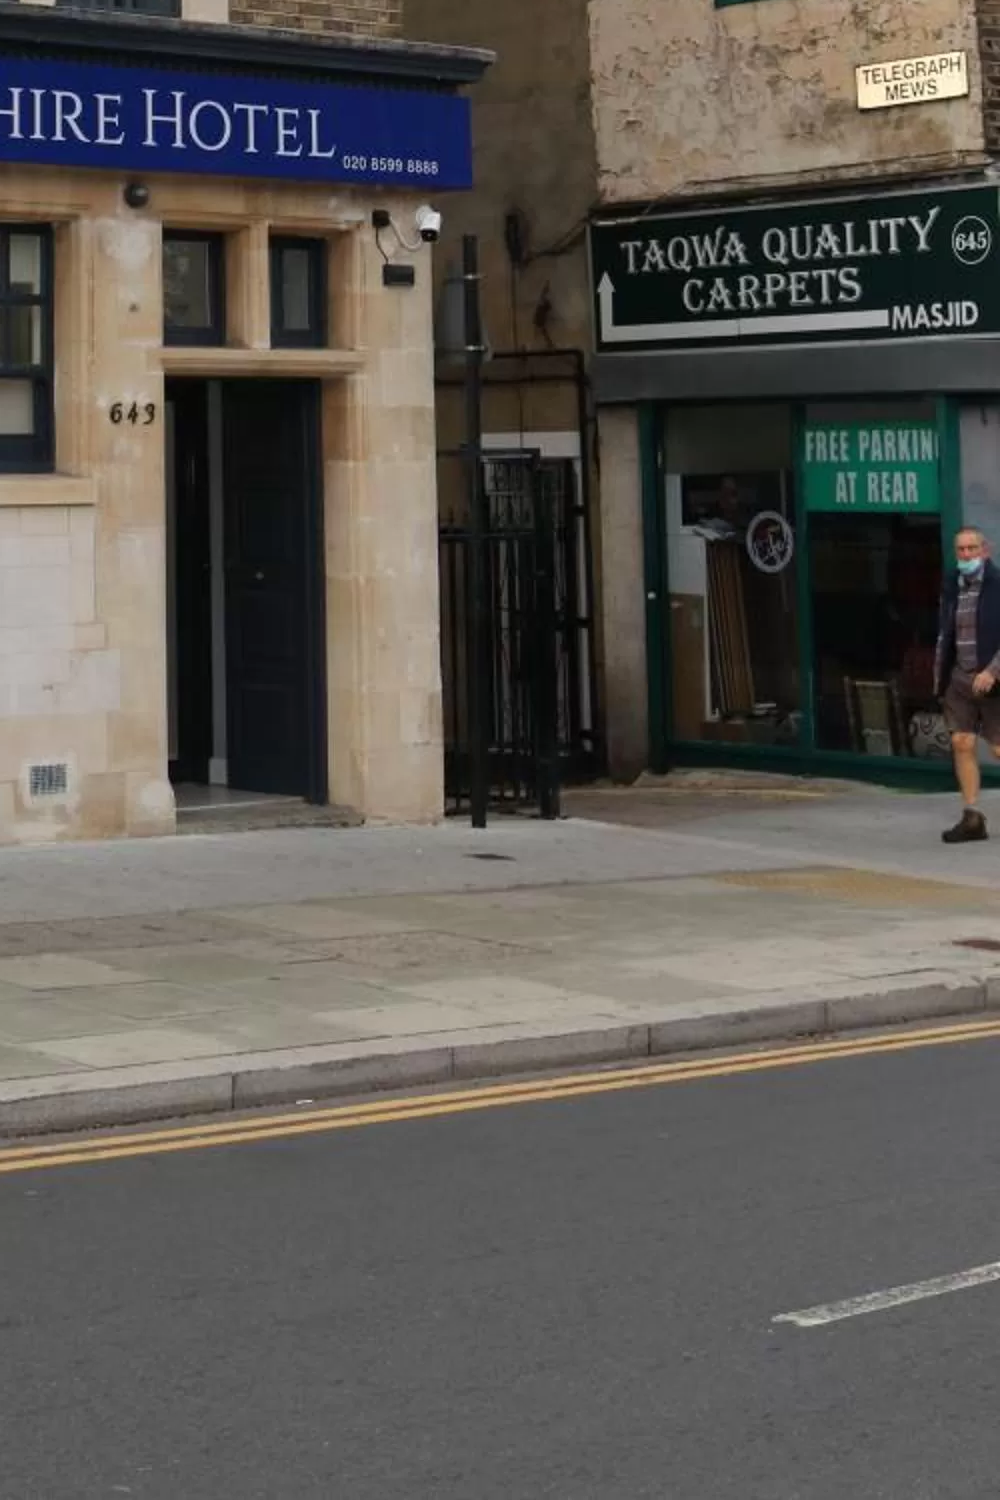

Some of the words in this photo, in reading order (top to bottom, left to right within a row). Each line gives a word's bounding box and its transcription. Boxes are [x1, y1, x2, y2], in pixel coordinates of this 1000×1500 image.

[862, 56, 961, 86] TELEGRAPH
[885, 78, 938, 100] MEWS
[141, 88, 337, 158] HOTEL
[343, 154, 367, 172] 020
[371, 156, 403, 173] 8599
[407, 159, 439, 175] 8888
[620, 226, 750, 275] TAQWA
[762, 205, 941, 266] QUALITY
[955, 231, 987, 251] 645
[682, 267, 863, 313] CARPETS
[891, 301, 979, 331] MASJID
[804, 429, 849, 463] FREE
[858, 428, 939, 463] PARKIN
[835, 471, 857, 503] AT
[867, 471, 919, 503] REAR
